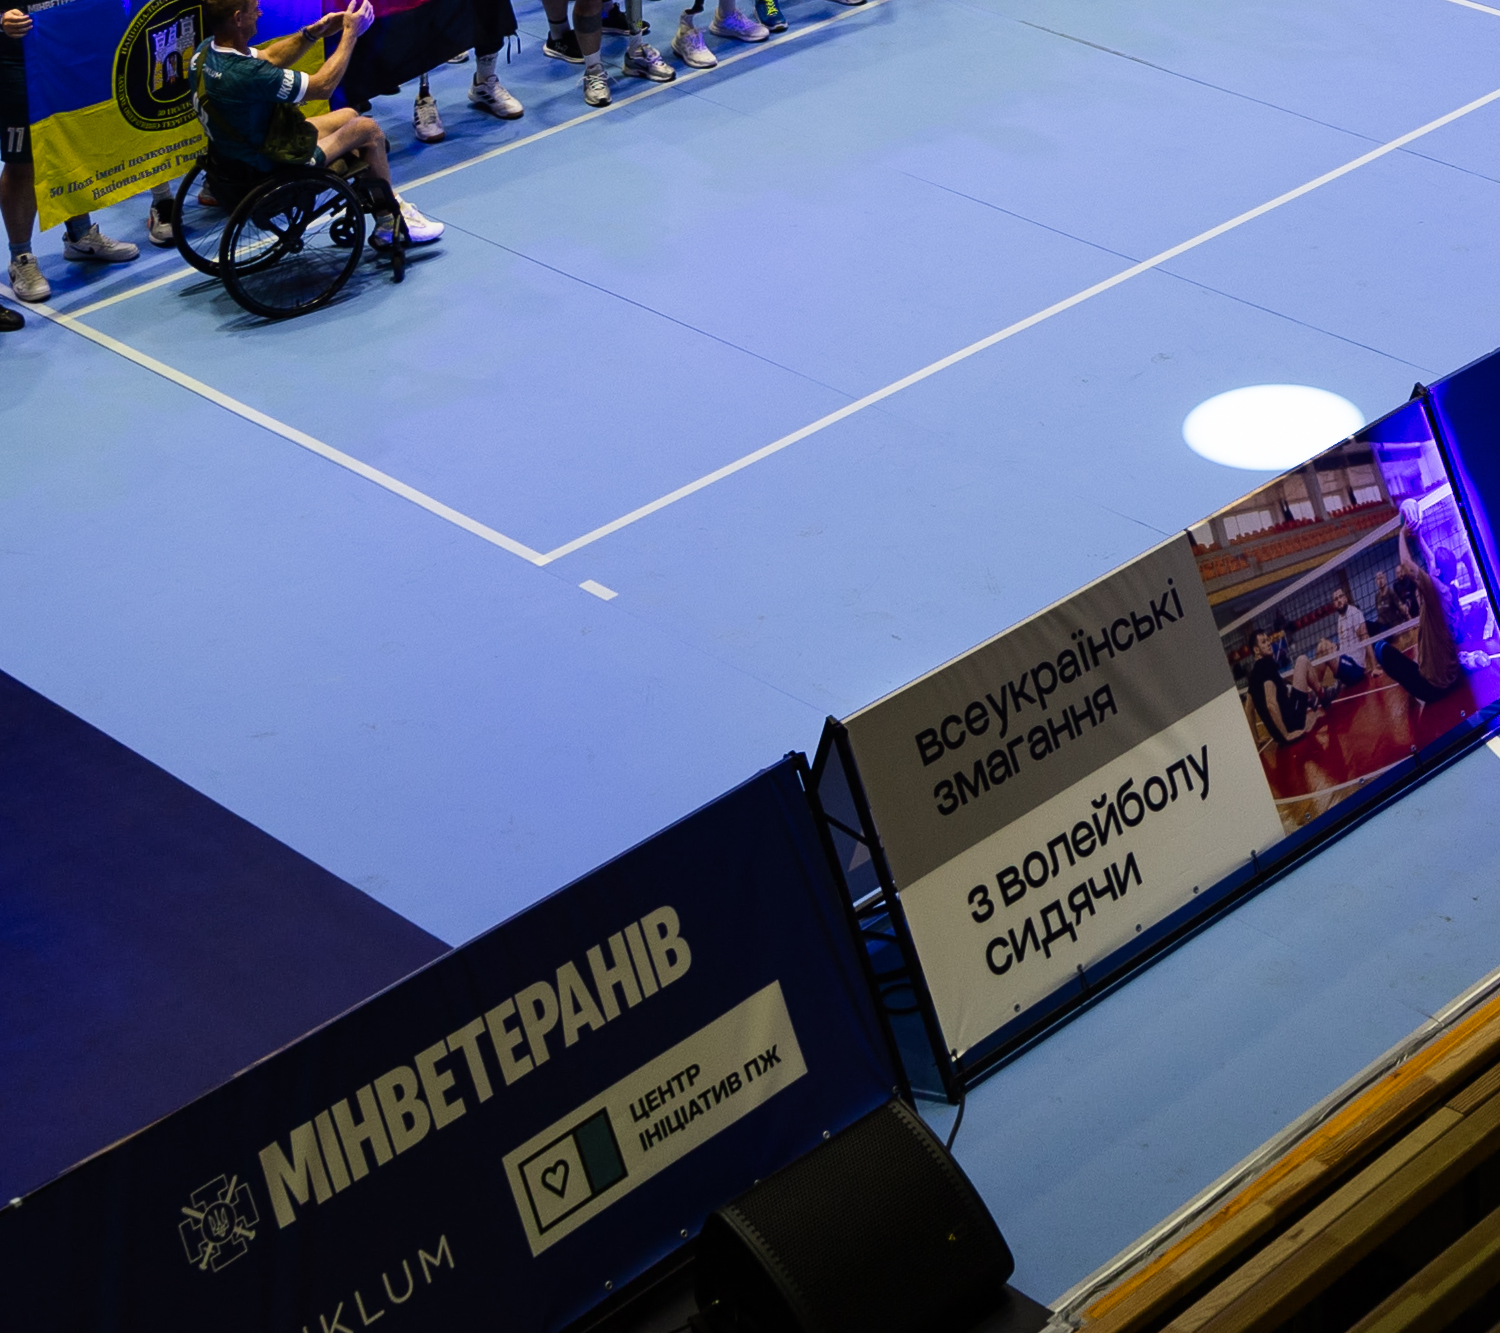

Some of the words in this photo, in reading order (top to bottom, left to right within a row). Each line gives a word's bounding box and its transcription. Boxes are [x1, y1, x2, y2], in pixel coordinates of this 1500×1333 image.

[7, 126, 25, 153] 11
[95, 163, 125, 182] імені
[914, 578, 1186, 769] всеукраїнські
[931, 684, 1119, 817] змагання
[967, 883, 994, 925] з
[1000, 745, 1213, 897] волейболу
[985, 850, 1144, 978] сидячи
[257, 903, 693, 1230] МІНВЕТЕРАНІВ
[629, 1061, 703, 1124] ЦЕНТР
[639, 1069, 745, 1153] ІНІЦІАТИВ
[742, 1044, 781, 1089] ПЖ
